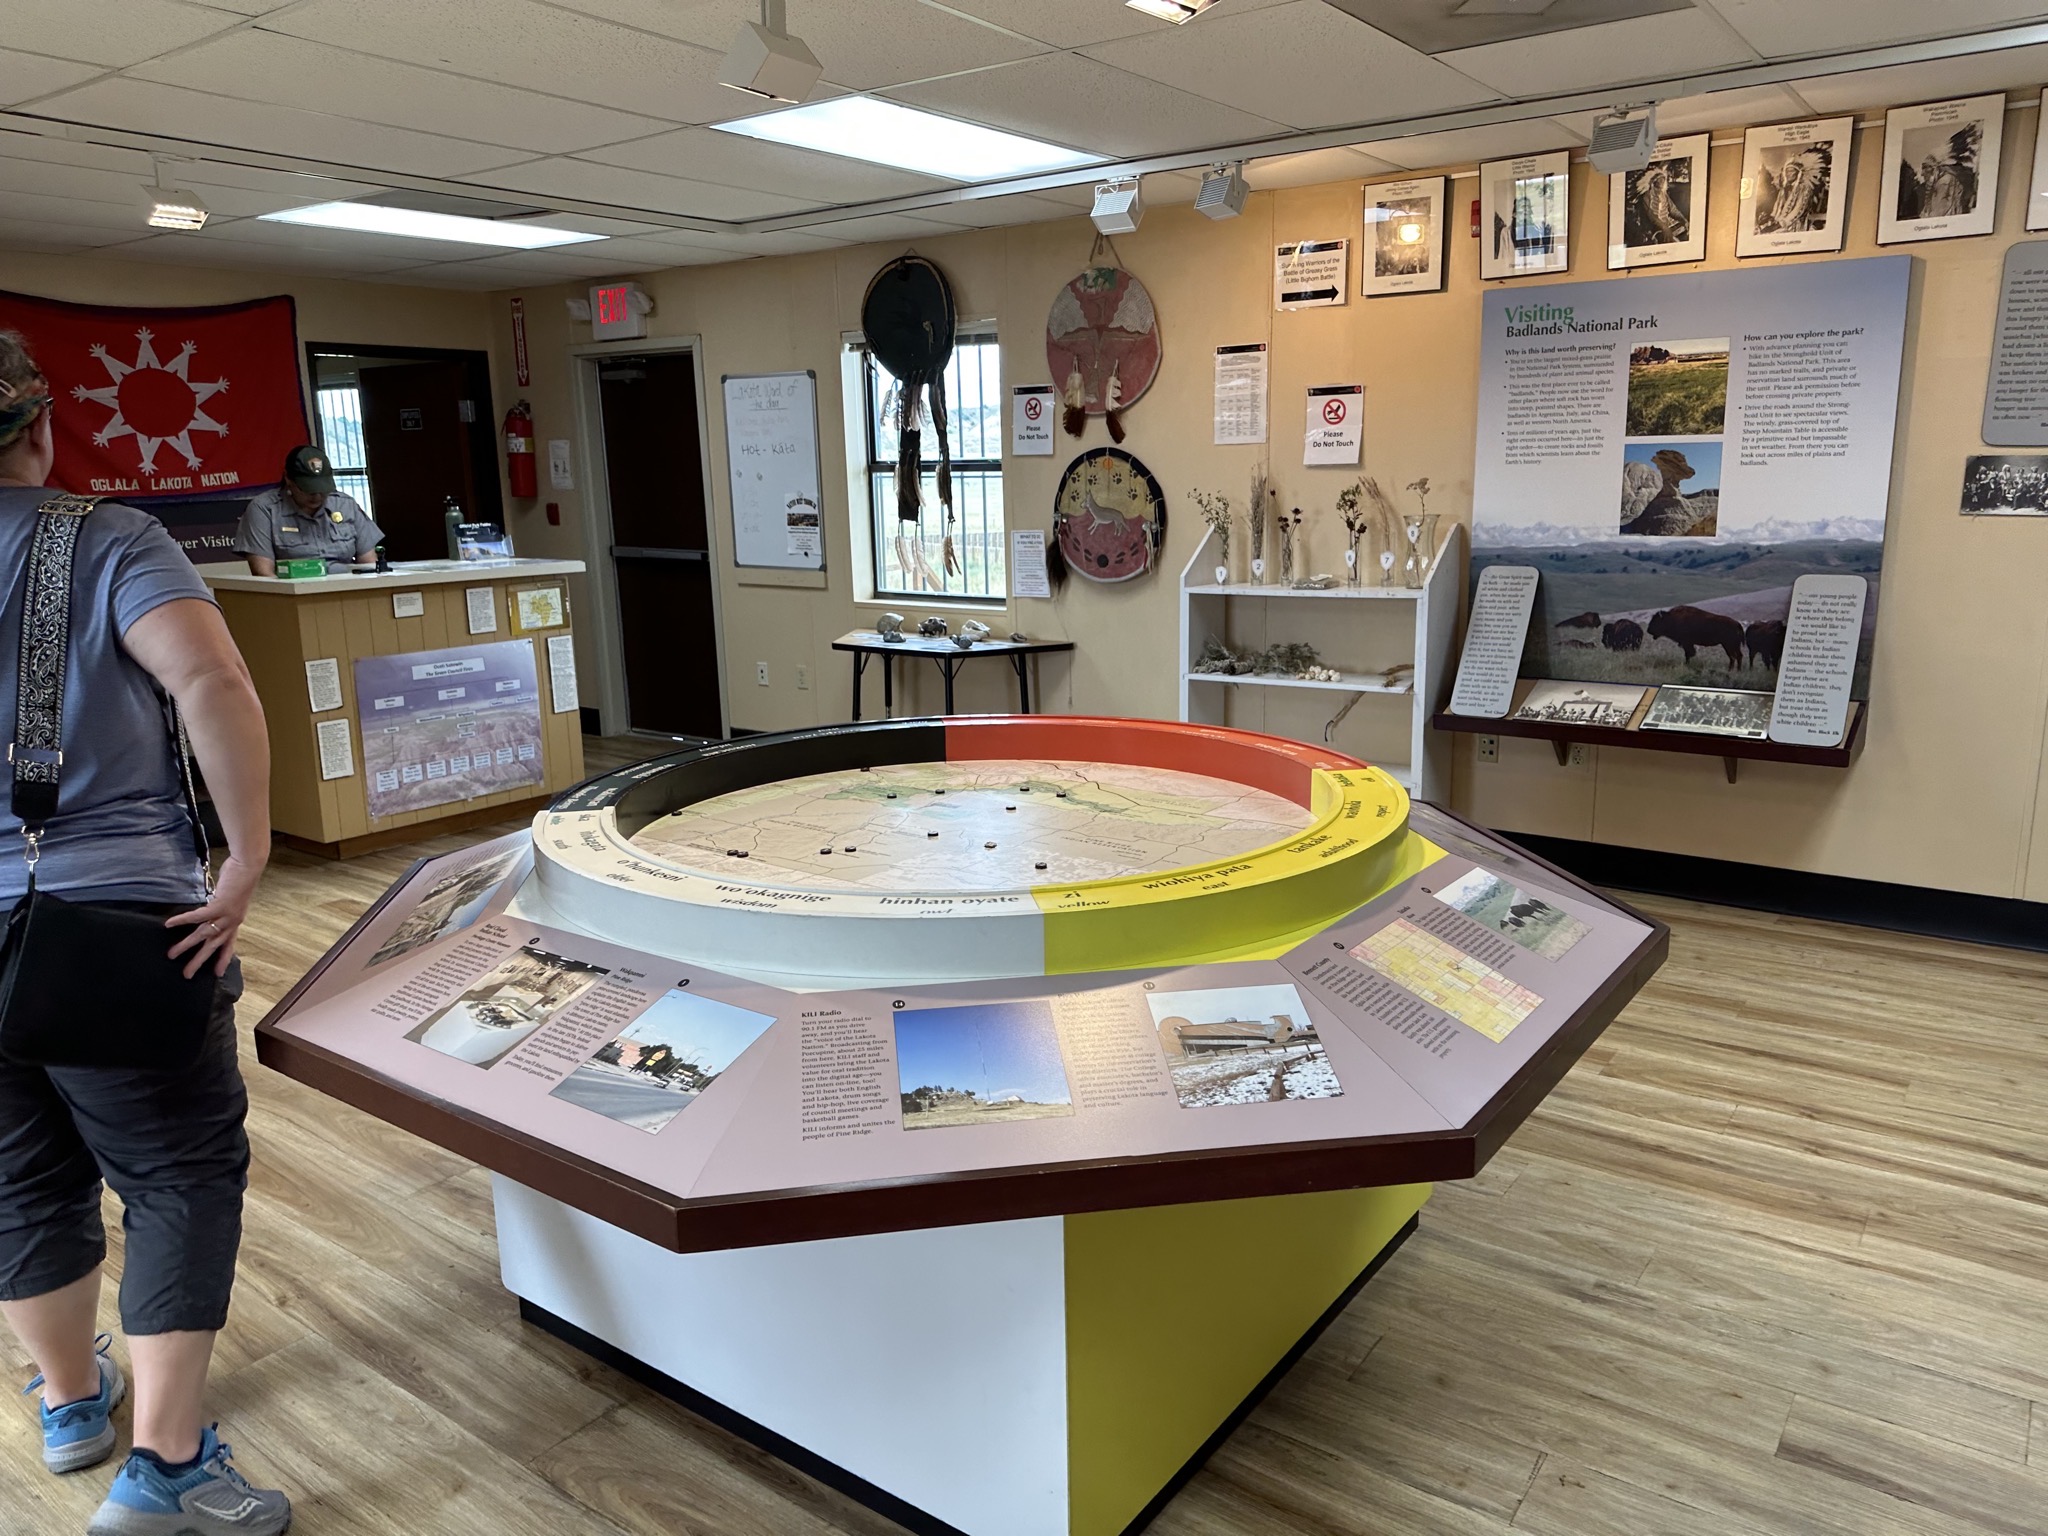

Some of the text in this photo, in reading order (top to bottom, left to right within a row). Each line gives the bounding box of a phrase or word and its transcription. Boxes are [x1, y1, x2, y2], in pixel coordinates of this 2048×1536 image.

[598, 288, 627, 324] EXIT
[1505, 304, 1574, 325] Visiting
[1507, 315, 1658, 337] Badlands National Park
[1796, 331, 1825, 340] explore
[1842, 328, 1864, 337] park?
[1578, 343, 1616, 352] preserving?
[90, 472, 240, 491] OGLALA LAKOTA NATION
[177, 540, 198, 549] ver
[1318, 838, 1358, 859] adulthood
[606, 873, 634, 882] elder
[1143, 864, 1253, 890] wiohiya pata
[1202, 881, 1230, 890] east
[962, 896, 1019, 905] oyate
[1063, 891, 1082, 899] zi
[721, 898, 778, 909] wisdom
[1058, 900, 1110, 909] yellow
